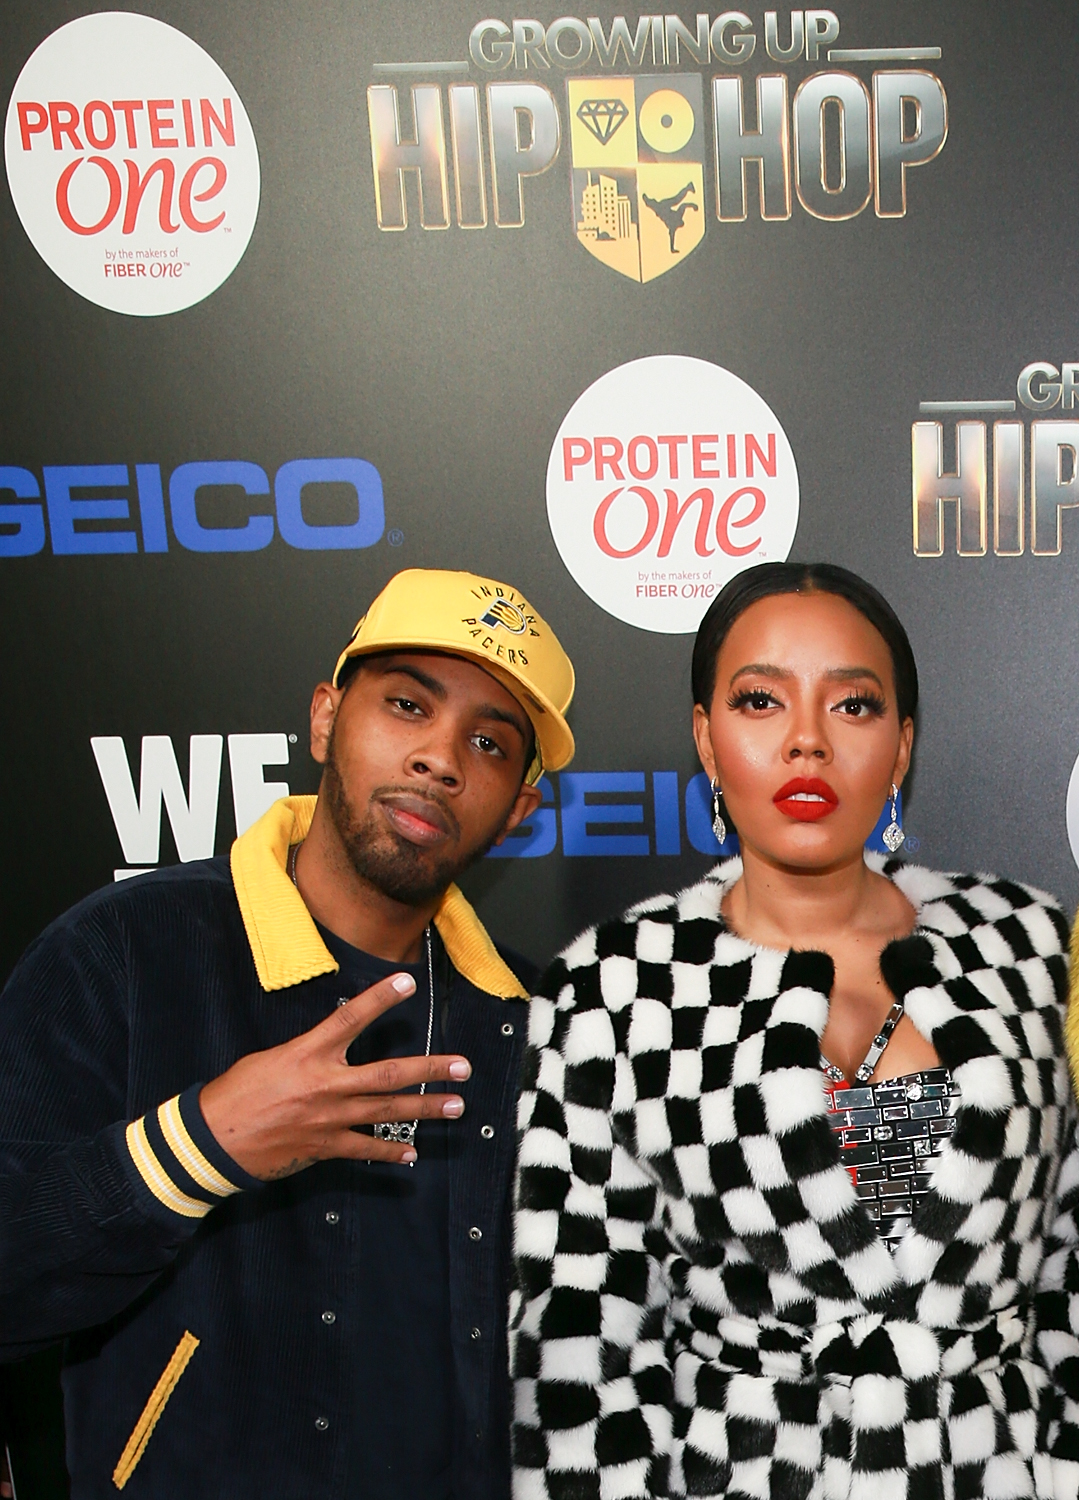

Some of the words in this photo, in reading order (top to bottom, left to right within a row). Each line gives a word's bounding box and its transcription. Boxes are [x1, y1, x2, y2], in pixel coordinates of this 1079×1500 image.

[469, 11, 757, 70] GROWING
[765, 9, 840, 61] UP
[16, 98, 236, 151] PROTEIN
[366, 82, 560, 231] HIP
[710, 69, 949, 222] HOP
[104, 263, 147, 278] FIBER
[105, 250, 116, 261] by
[119, 249, 133, 259] the
[136, 248, 168, 259] makers
[170, 247, 179, 258] of
[563, 433, 778, 482] PROTEIN
[636, 585, 678, 598] FIBER
[638, 571, 649, 582] by
[652, 571, 666, 580] the
[668, 571, 701, 580] makers
[703, 570, 712, 580] of
[470, 585, 540, 639] INDIANA
[462, 616, 529, 666] PACERS
